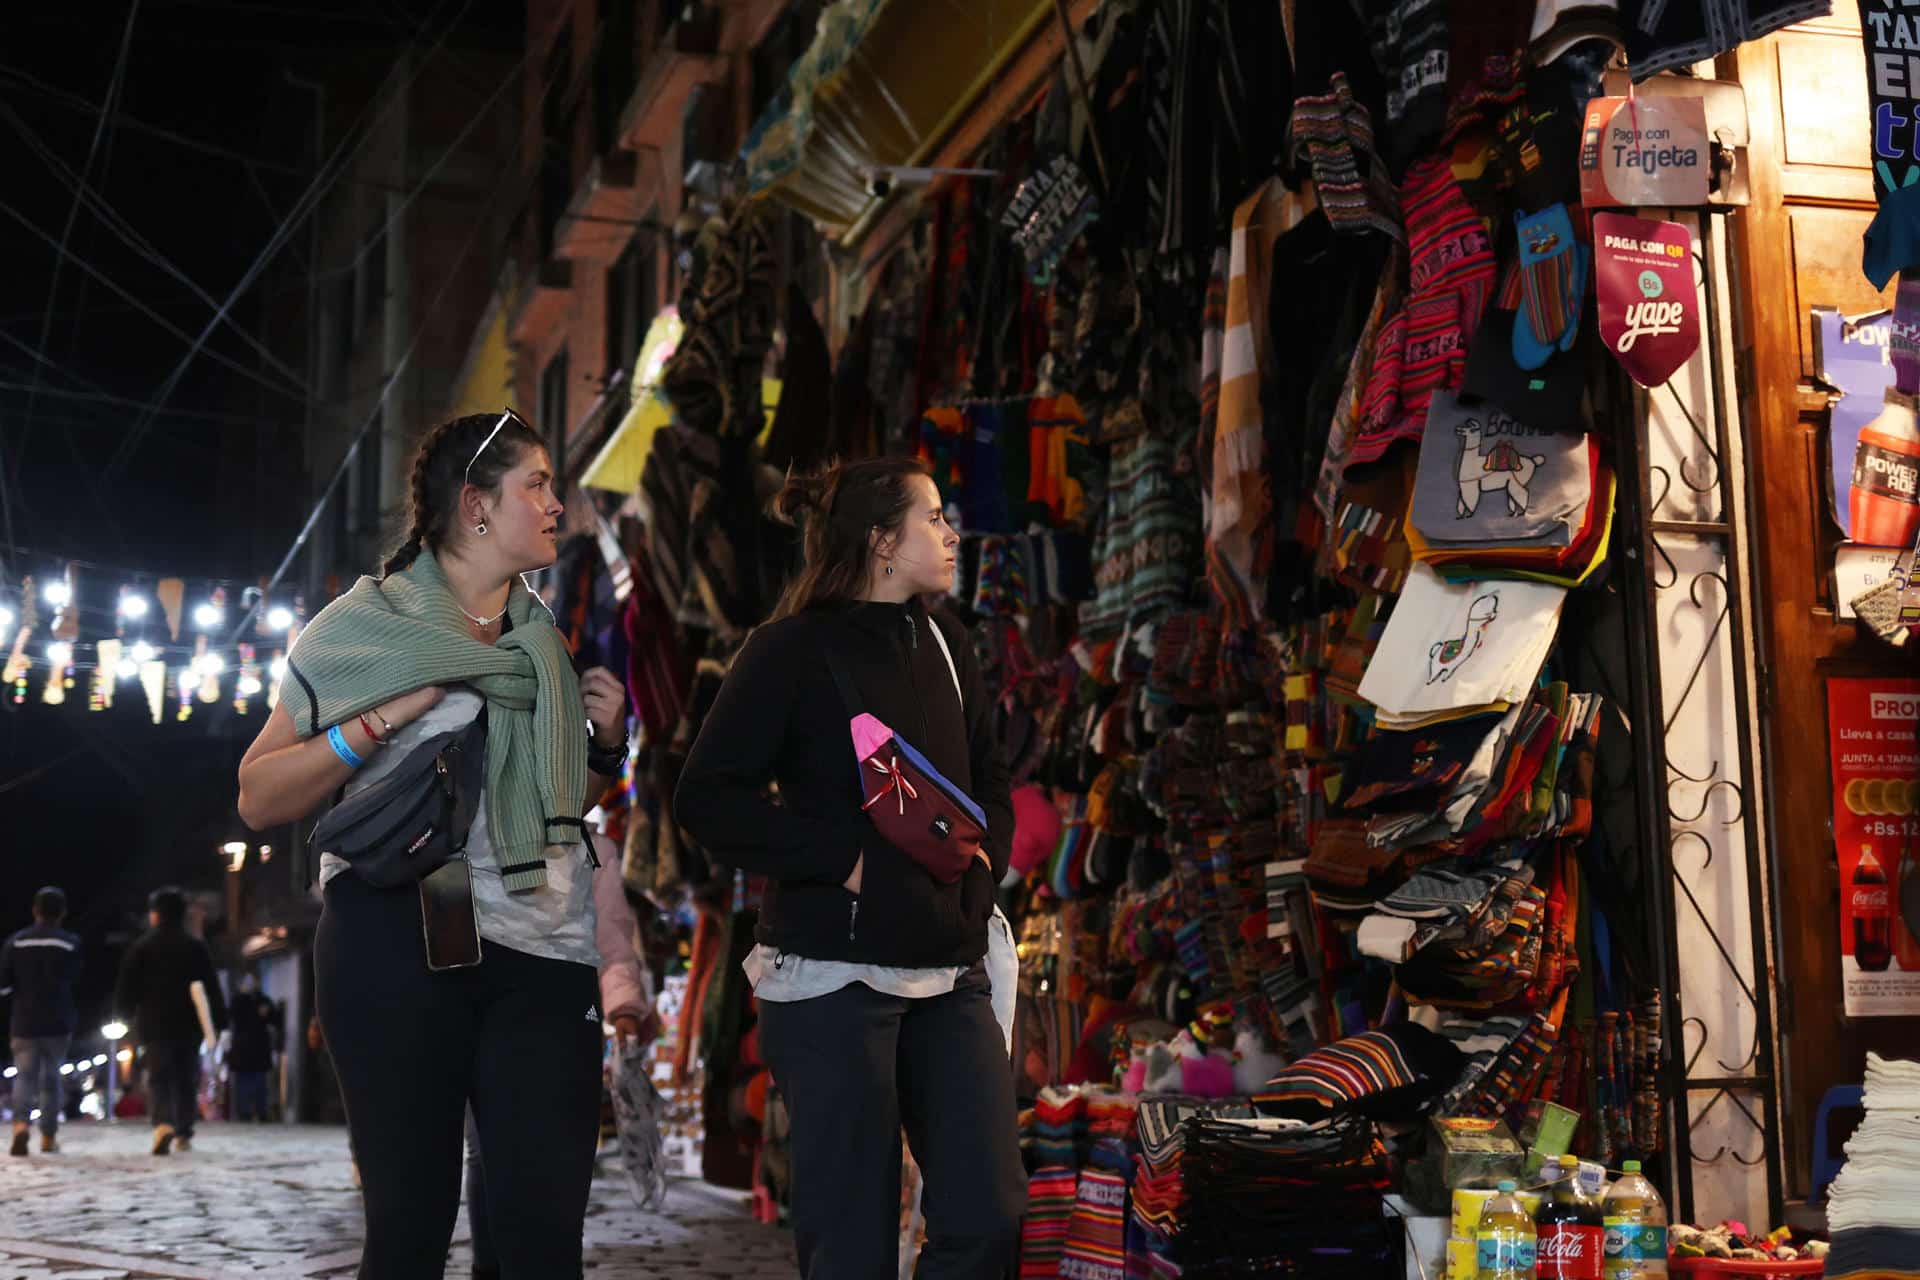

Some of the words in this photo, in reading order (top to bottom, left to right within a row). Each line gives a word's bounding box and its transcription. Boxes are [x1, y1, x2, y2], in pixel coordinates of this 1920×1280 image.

[1613, 128, 1642, 143] Paga
[1646, 129, 1670, 140] con
[1612, 144, 1697, 174] Tarjeta
[1605, 235, 1638, 251] PAGA
[1640, 241, 1665, 255] CON
[1666, 244, 1684, 258] QR
[1617, 302, 1683, 353] yape
[1865, 455, 1918, 481] POWER
[1888, 475, 1916, 494] ADE
[1840, 728, 1873, 740] Lleva
[1841, 753, 1873, 763] JUNTA
